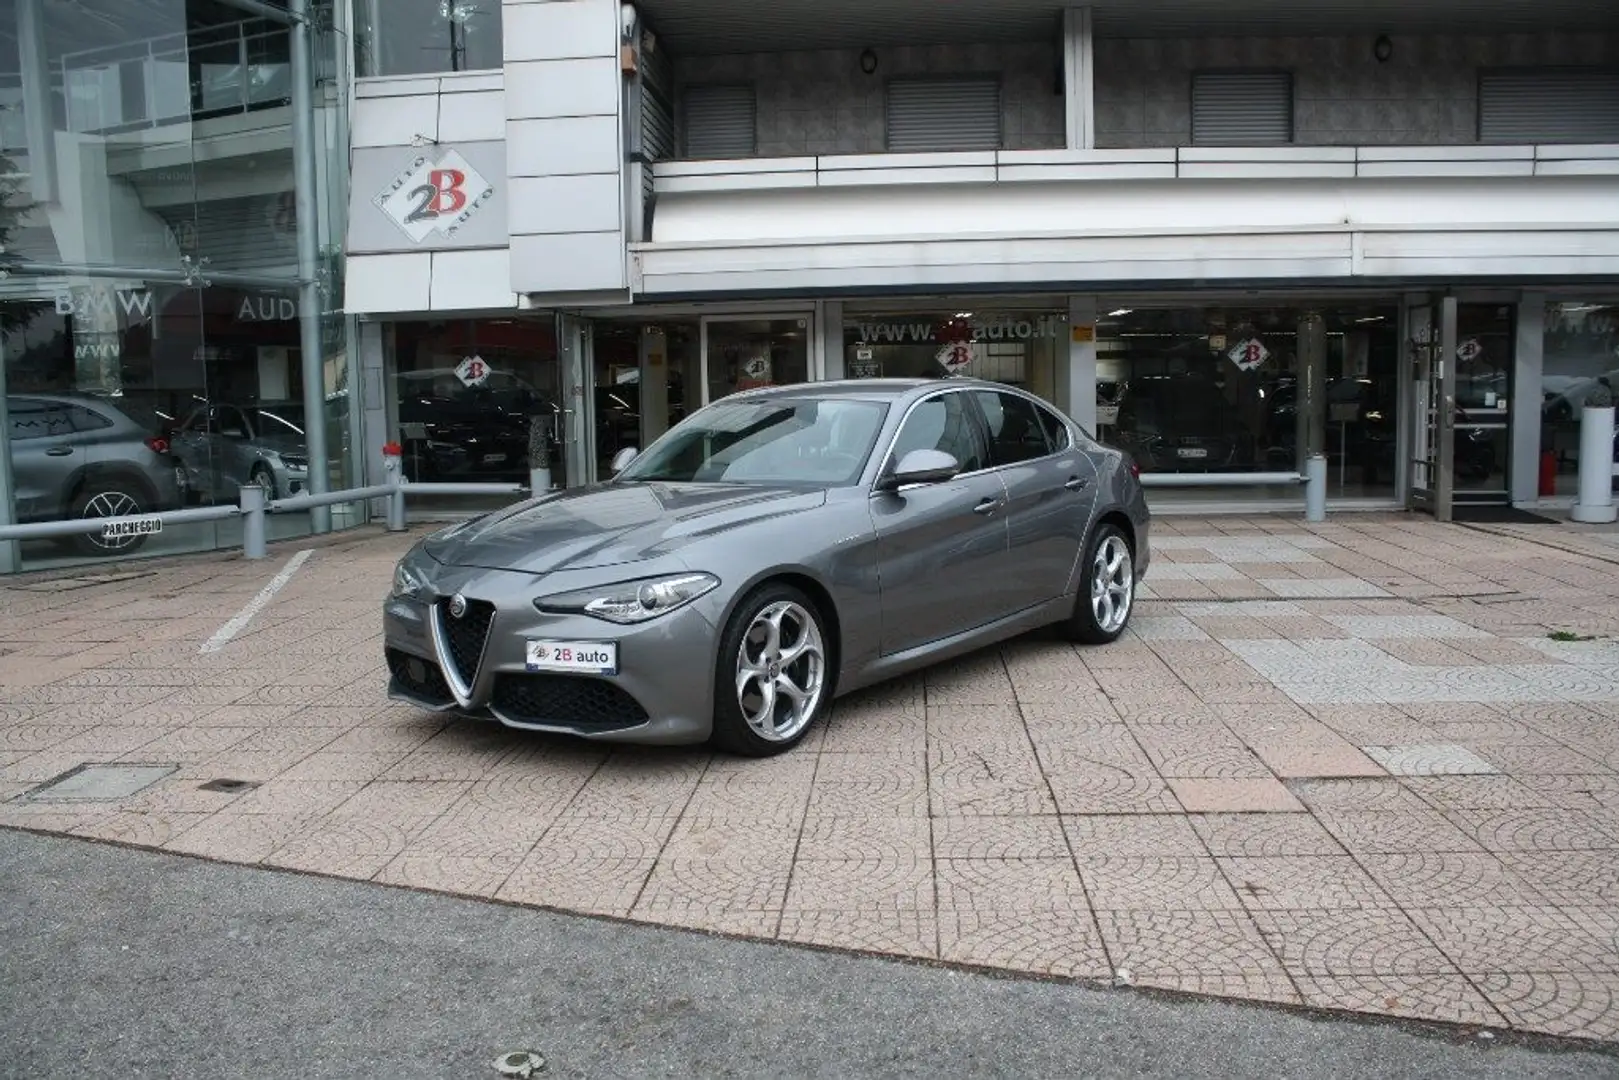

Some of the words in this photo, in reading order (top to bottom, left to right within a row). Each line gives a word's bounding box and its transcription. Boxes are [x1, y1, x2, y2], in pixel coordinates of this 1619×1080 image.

[403, 168, 466, 225] 2B
[56, 290, 152, 316] BMW
[238, 295, 301, 321] AUD
[103, 518, 161, 535] PARCHEGGIO
[554, 648, 572, 661] 2B
[577, 651, 609, 663] auto
